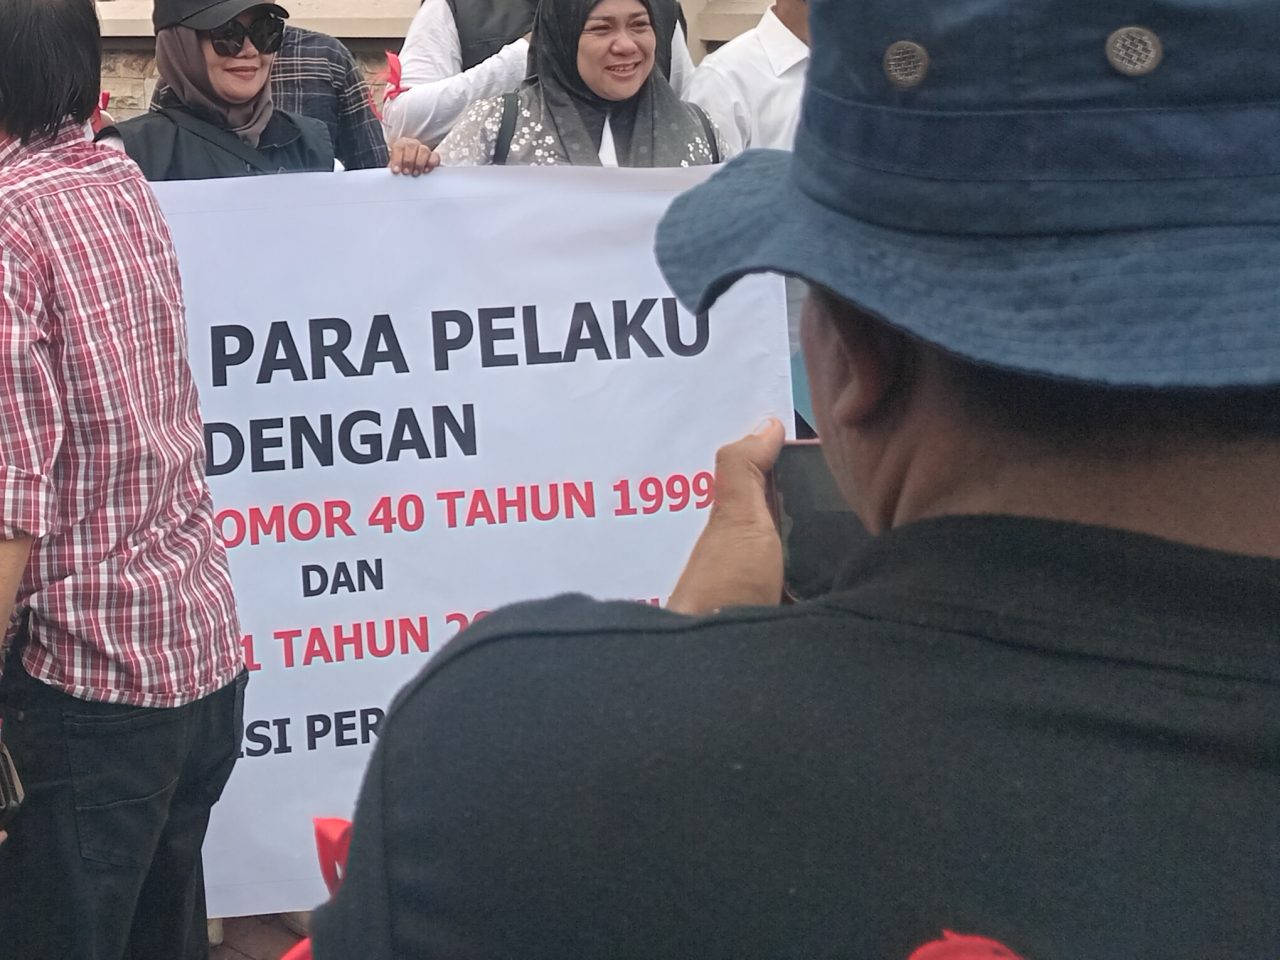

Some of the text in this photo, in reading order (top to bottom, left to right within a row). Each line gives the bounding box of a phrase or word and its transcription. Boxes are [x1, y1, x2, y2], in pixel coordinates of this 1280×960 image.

[211, 297, 711, 386] PARA PELAKU
[204, 403, 478, 476] DENGAN
[214, 471, 715, 549] OMOR 40 TAHUN 1999
[301, 558, 384, 598] DAN
[240, 634, 262, 672] 1
[273, 615, 430, 668] TAHUN
[241, 706, 386, 758] SI PER
